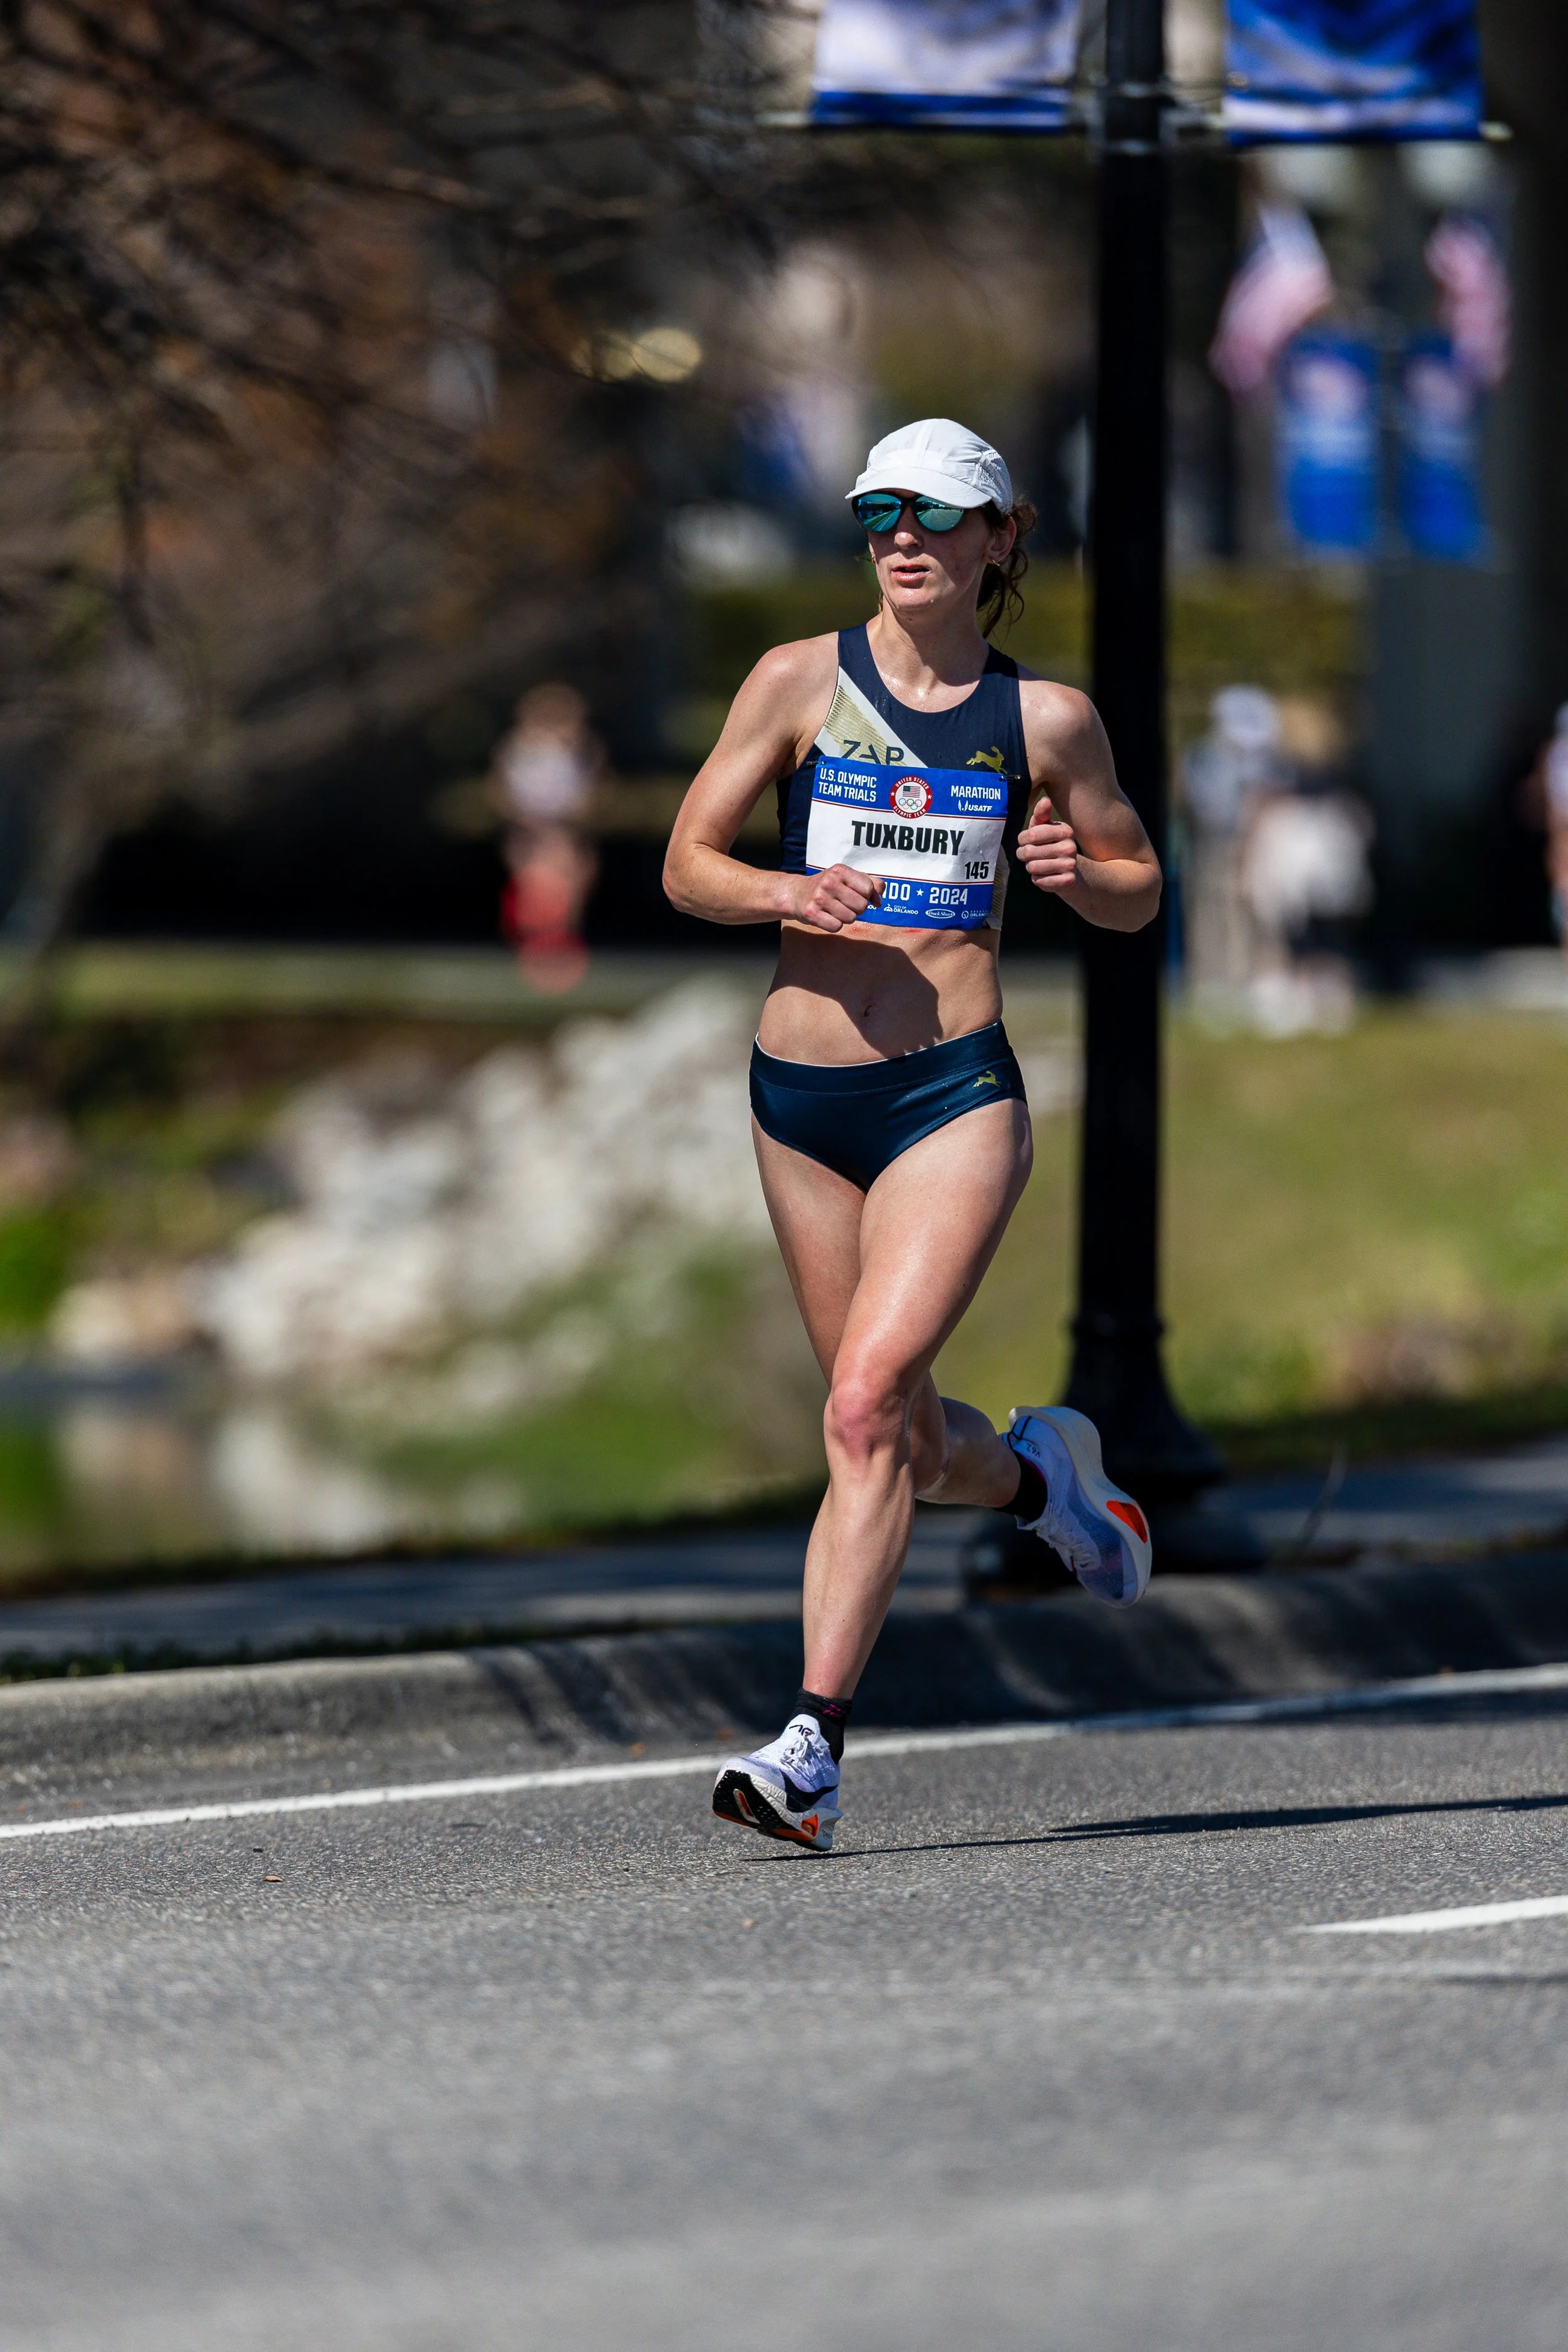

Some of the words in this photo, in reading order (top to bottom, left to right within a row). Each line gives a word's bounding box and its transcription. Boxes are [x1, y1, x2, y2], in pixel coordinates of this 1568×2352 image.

[841, 740, 904, 765] ZAP
[820, 768, 836, 782] U.S.
[837, 771, 877, 788] OLYMPIC
[895, 776, 912, 788] UNITED
[913, 777, 930, 790] STATES
[818, 781, 842, 797] TEAM
[844, 787, 877, 802] TRIALS
[950, 785, 1001, 800] MARATHON
[893, 805, 912, 818] OLYMPIC
[914, 808, 926, 818] TEAM
[968, 804, 993, 812] USATF
[851, 820, 965, 856] TUXBURY
[964, 861, 990, 879] 145
[929, 887, 968, 905] 2024
